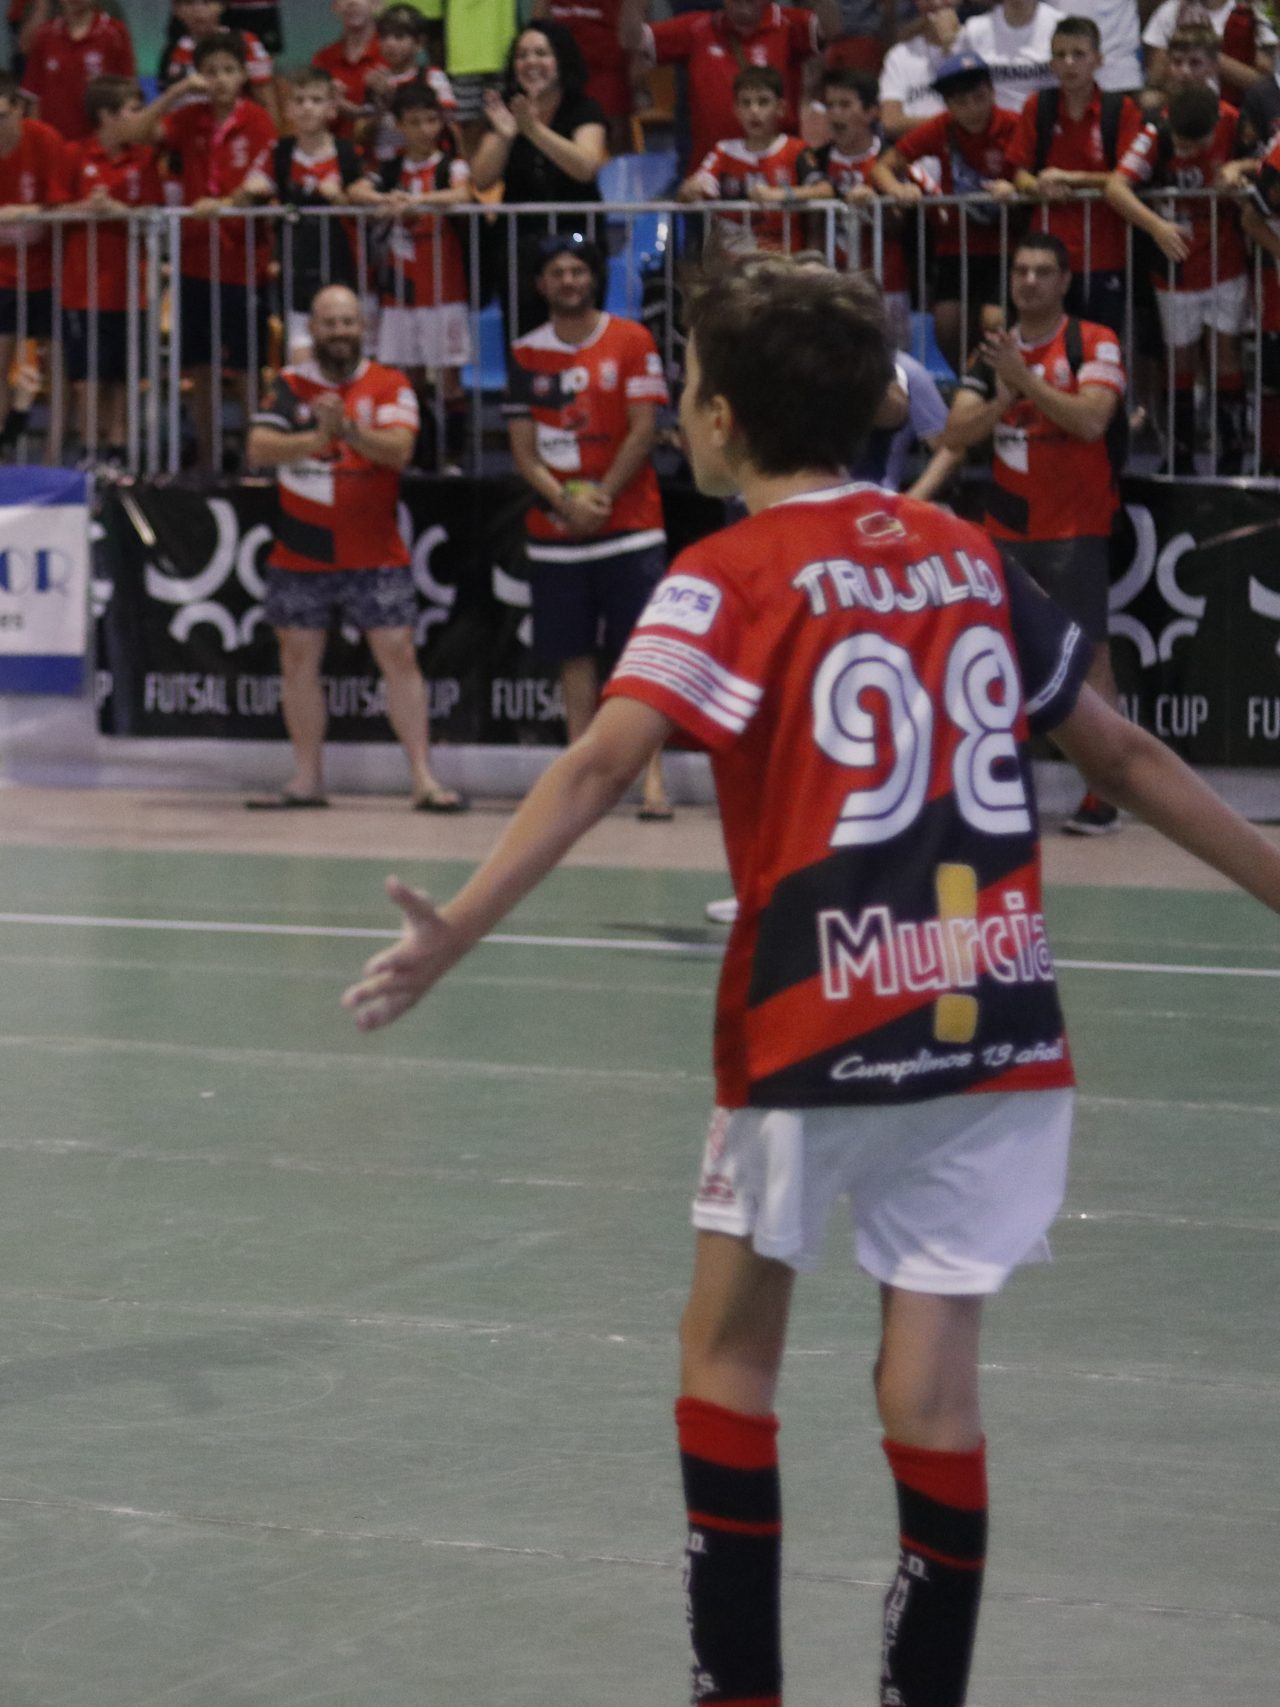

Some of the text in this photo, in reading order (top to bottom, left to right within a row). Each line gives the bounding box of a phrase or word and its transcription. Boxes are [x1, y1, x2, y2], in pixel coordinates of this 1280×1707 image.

[792, 550, 1002, 615] TRUJILLO
[144, 672, 230, 716] FUTSAL
[426, 678, 460, 717] UP
[492, 677, 567, 721] FUTSA
[1155, 694, 1209, 737] CUP
[813, 625, 1032, 847] 98
[818, 891, 1055, 999] Murcia
